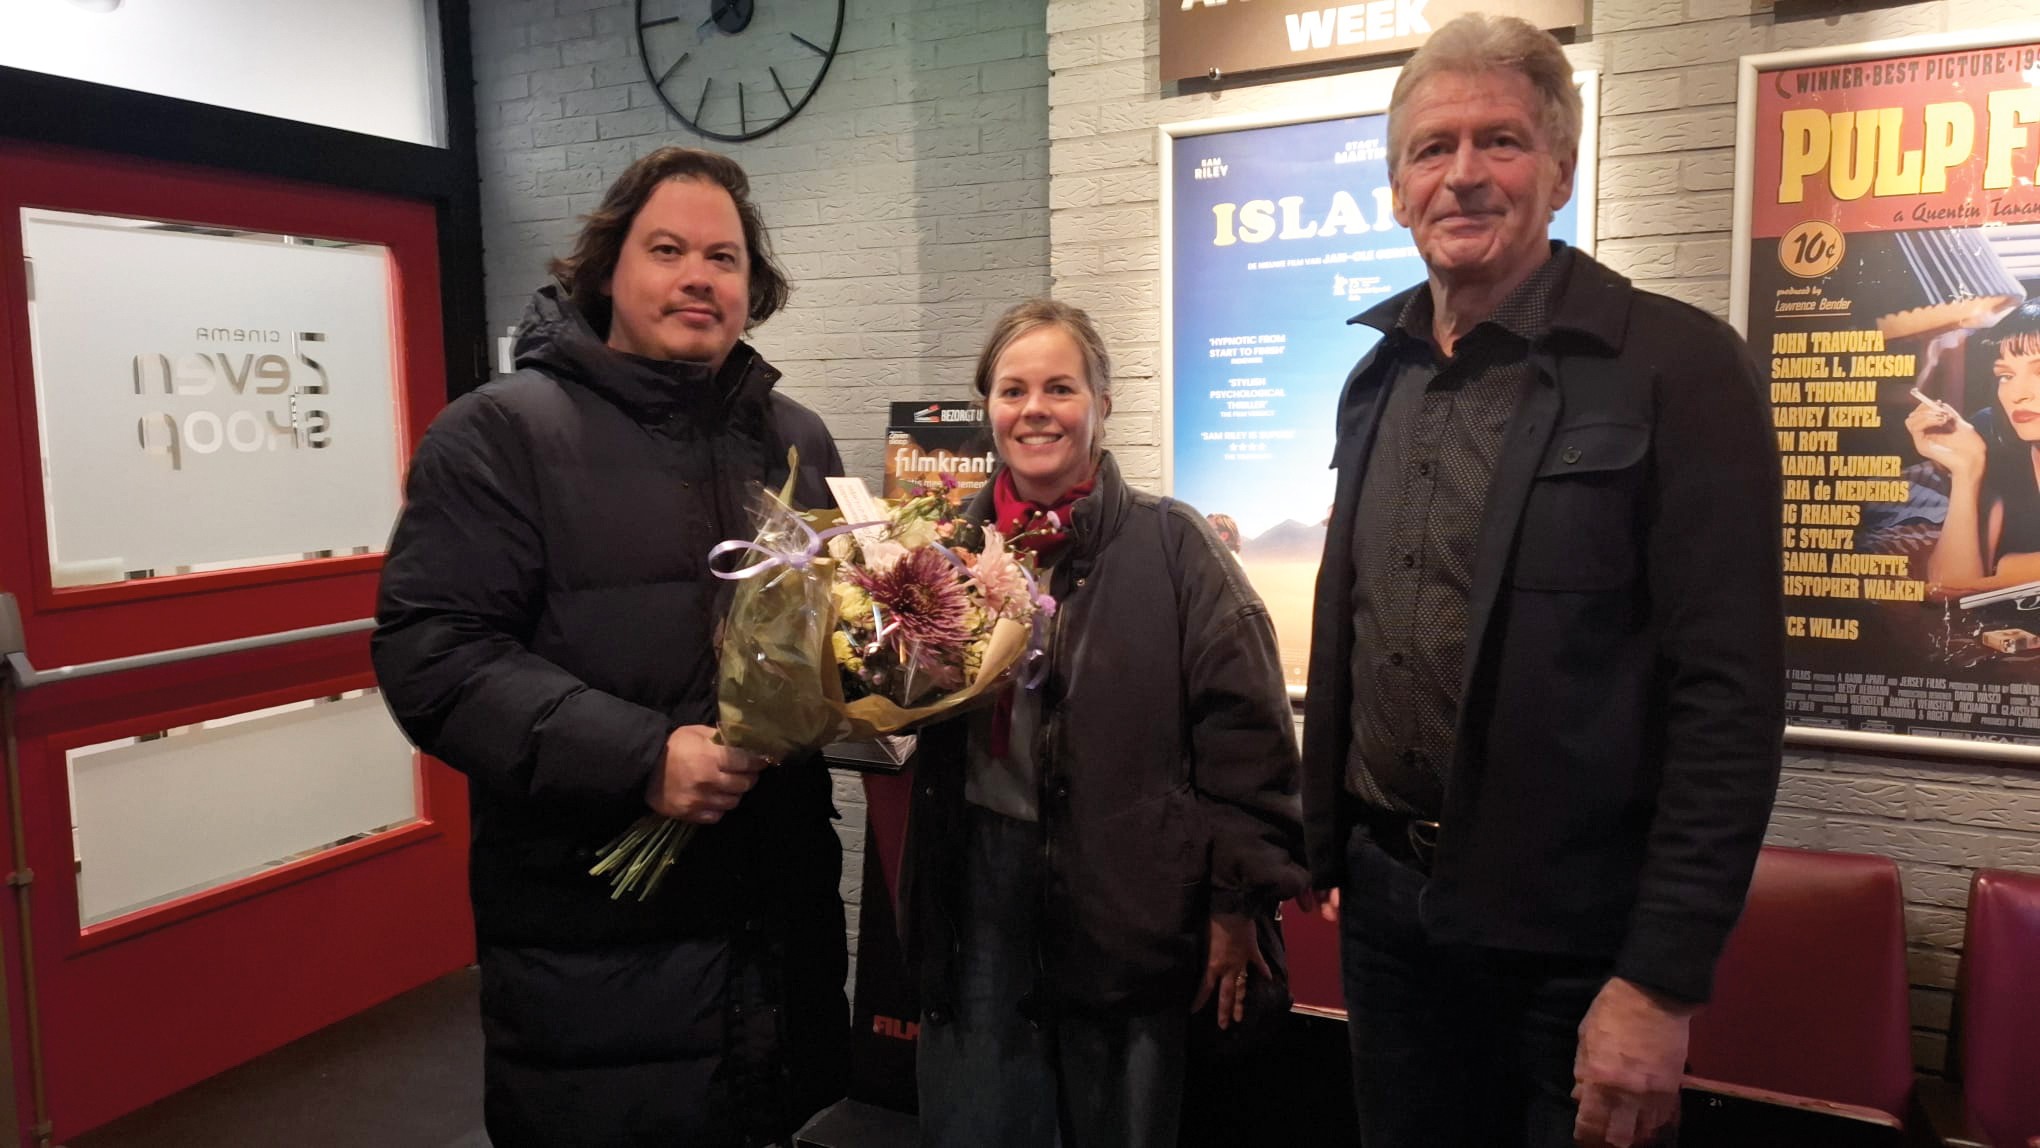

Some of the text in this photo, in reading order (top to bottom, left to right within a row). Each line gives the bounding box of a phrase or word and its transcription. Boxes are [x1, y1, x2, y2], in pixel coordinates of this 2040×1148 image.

[1285, 0, 1431, 51] WEEK
[1796, 68, 1864, 94] WINNER
[1872, 61, 1919, 86] BEST
[1926, 52, 2006, 82] PICTURE
[1778, 88, 2040, 204] PULP F
[1194, 165, 1229, 180] RILEY
[1201, 157, 1222, 167] SAM
[1912, 202, 1982, 223] Quentin
[1775, 297, 1852, 312] Lawrence Bender
[1209, 348, 1238, 358] START
[1240, 347, 1252, 356] TO
[1772, 330, 1885, 354] JOHN TRAVOLTA
[1771, 354, 1916, 379] SAMUEL L. JACKSON
[1771, 381, 1877, 403] UMA THURMAN
[940, 409, 975, 422] BEZORGT
[1828, 405, 1881, 428] KEITEL
[1777, 431, 1838, 452] IM ROTH
[894, 447, 995, 478] filmkrant
[1782, 455, 1901, 477] ANDA PLUMMER
[1783, 480, 1909, 502] RIA de MEDEIROS
[1801, 504, 1860, 526] RHAMES
[1800, 528, 1854, 550] STOLTZ
[1783, 551, 1909, 577] SANNA ARQUETTE
[1783, 575, 1925, 602] ISTOPHER WALKEN
[1809, 617, 1859, 640] WILLIS
